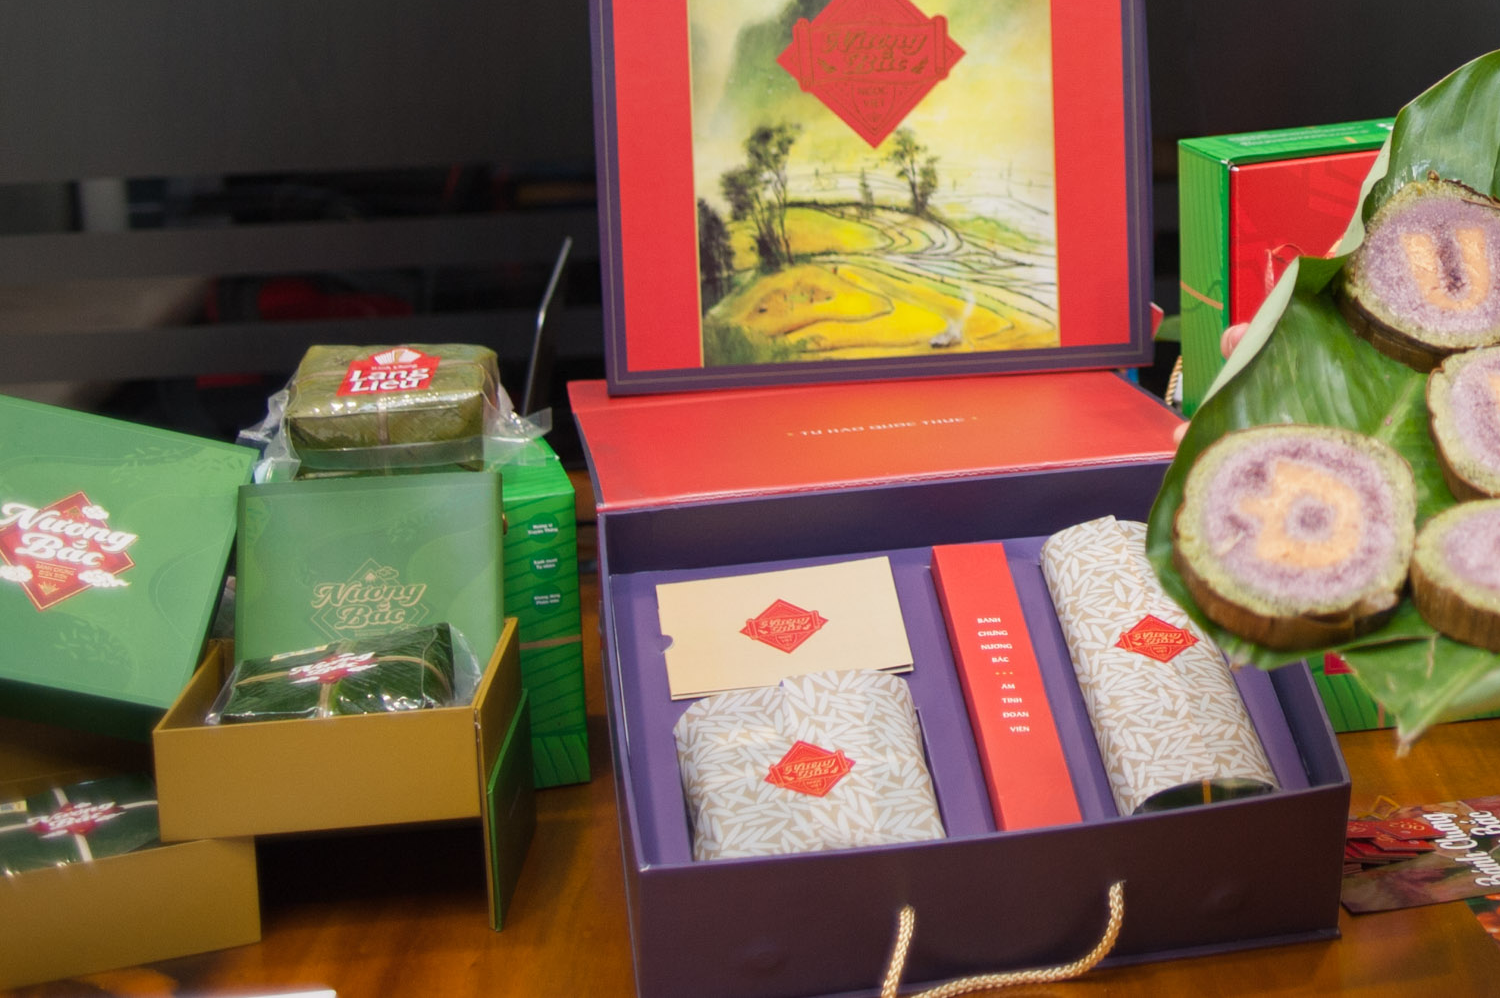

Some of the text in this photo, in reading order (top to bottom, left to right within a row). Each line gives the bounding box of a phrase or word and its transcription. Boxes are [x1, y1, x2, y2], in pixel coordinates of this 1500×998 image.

[350, 368, 430, 383] Lang
[0, 502, 139, 553] Nương
[311, 581, 428, 610] Nương
